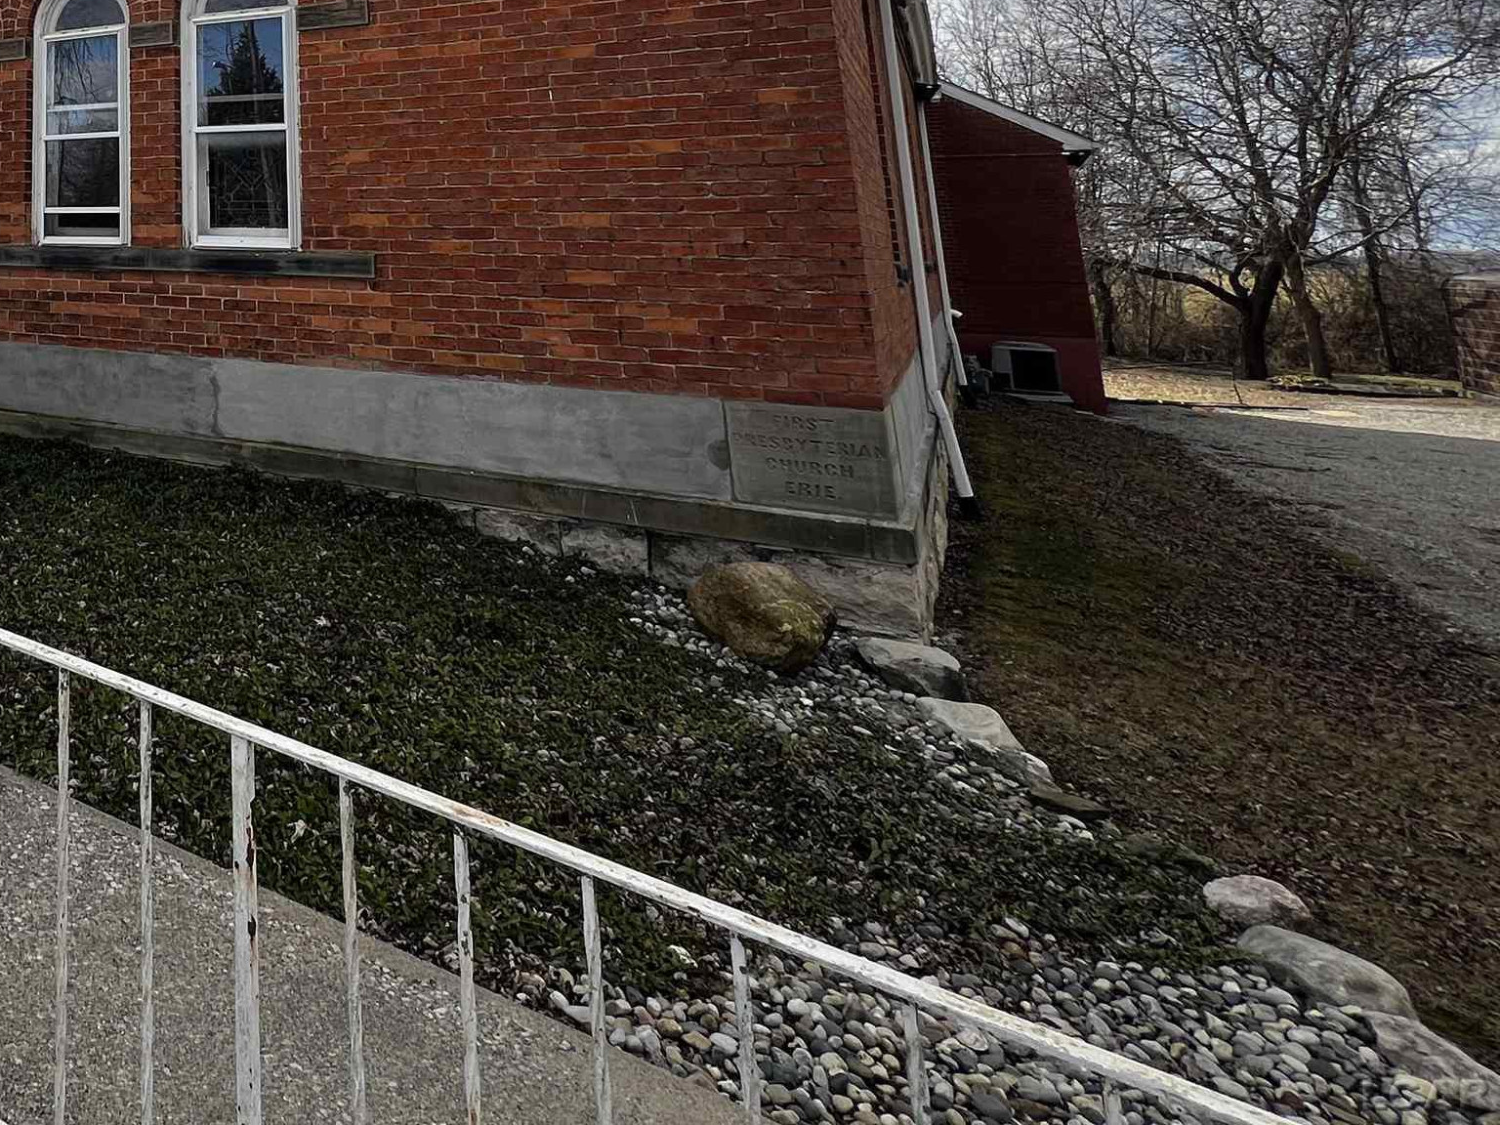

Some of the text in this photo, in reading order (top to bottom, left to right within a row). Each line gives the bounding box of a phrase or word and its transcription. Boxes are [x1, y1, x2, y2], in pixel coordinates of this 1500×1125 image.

[773, 414, 836, 432] FIRST
[732, 431, 887, 460] PRESBYTERIAN
[765, 457, 855, 479] CHURCH
